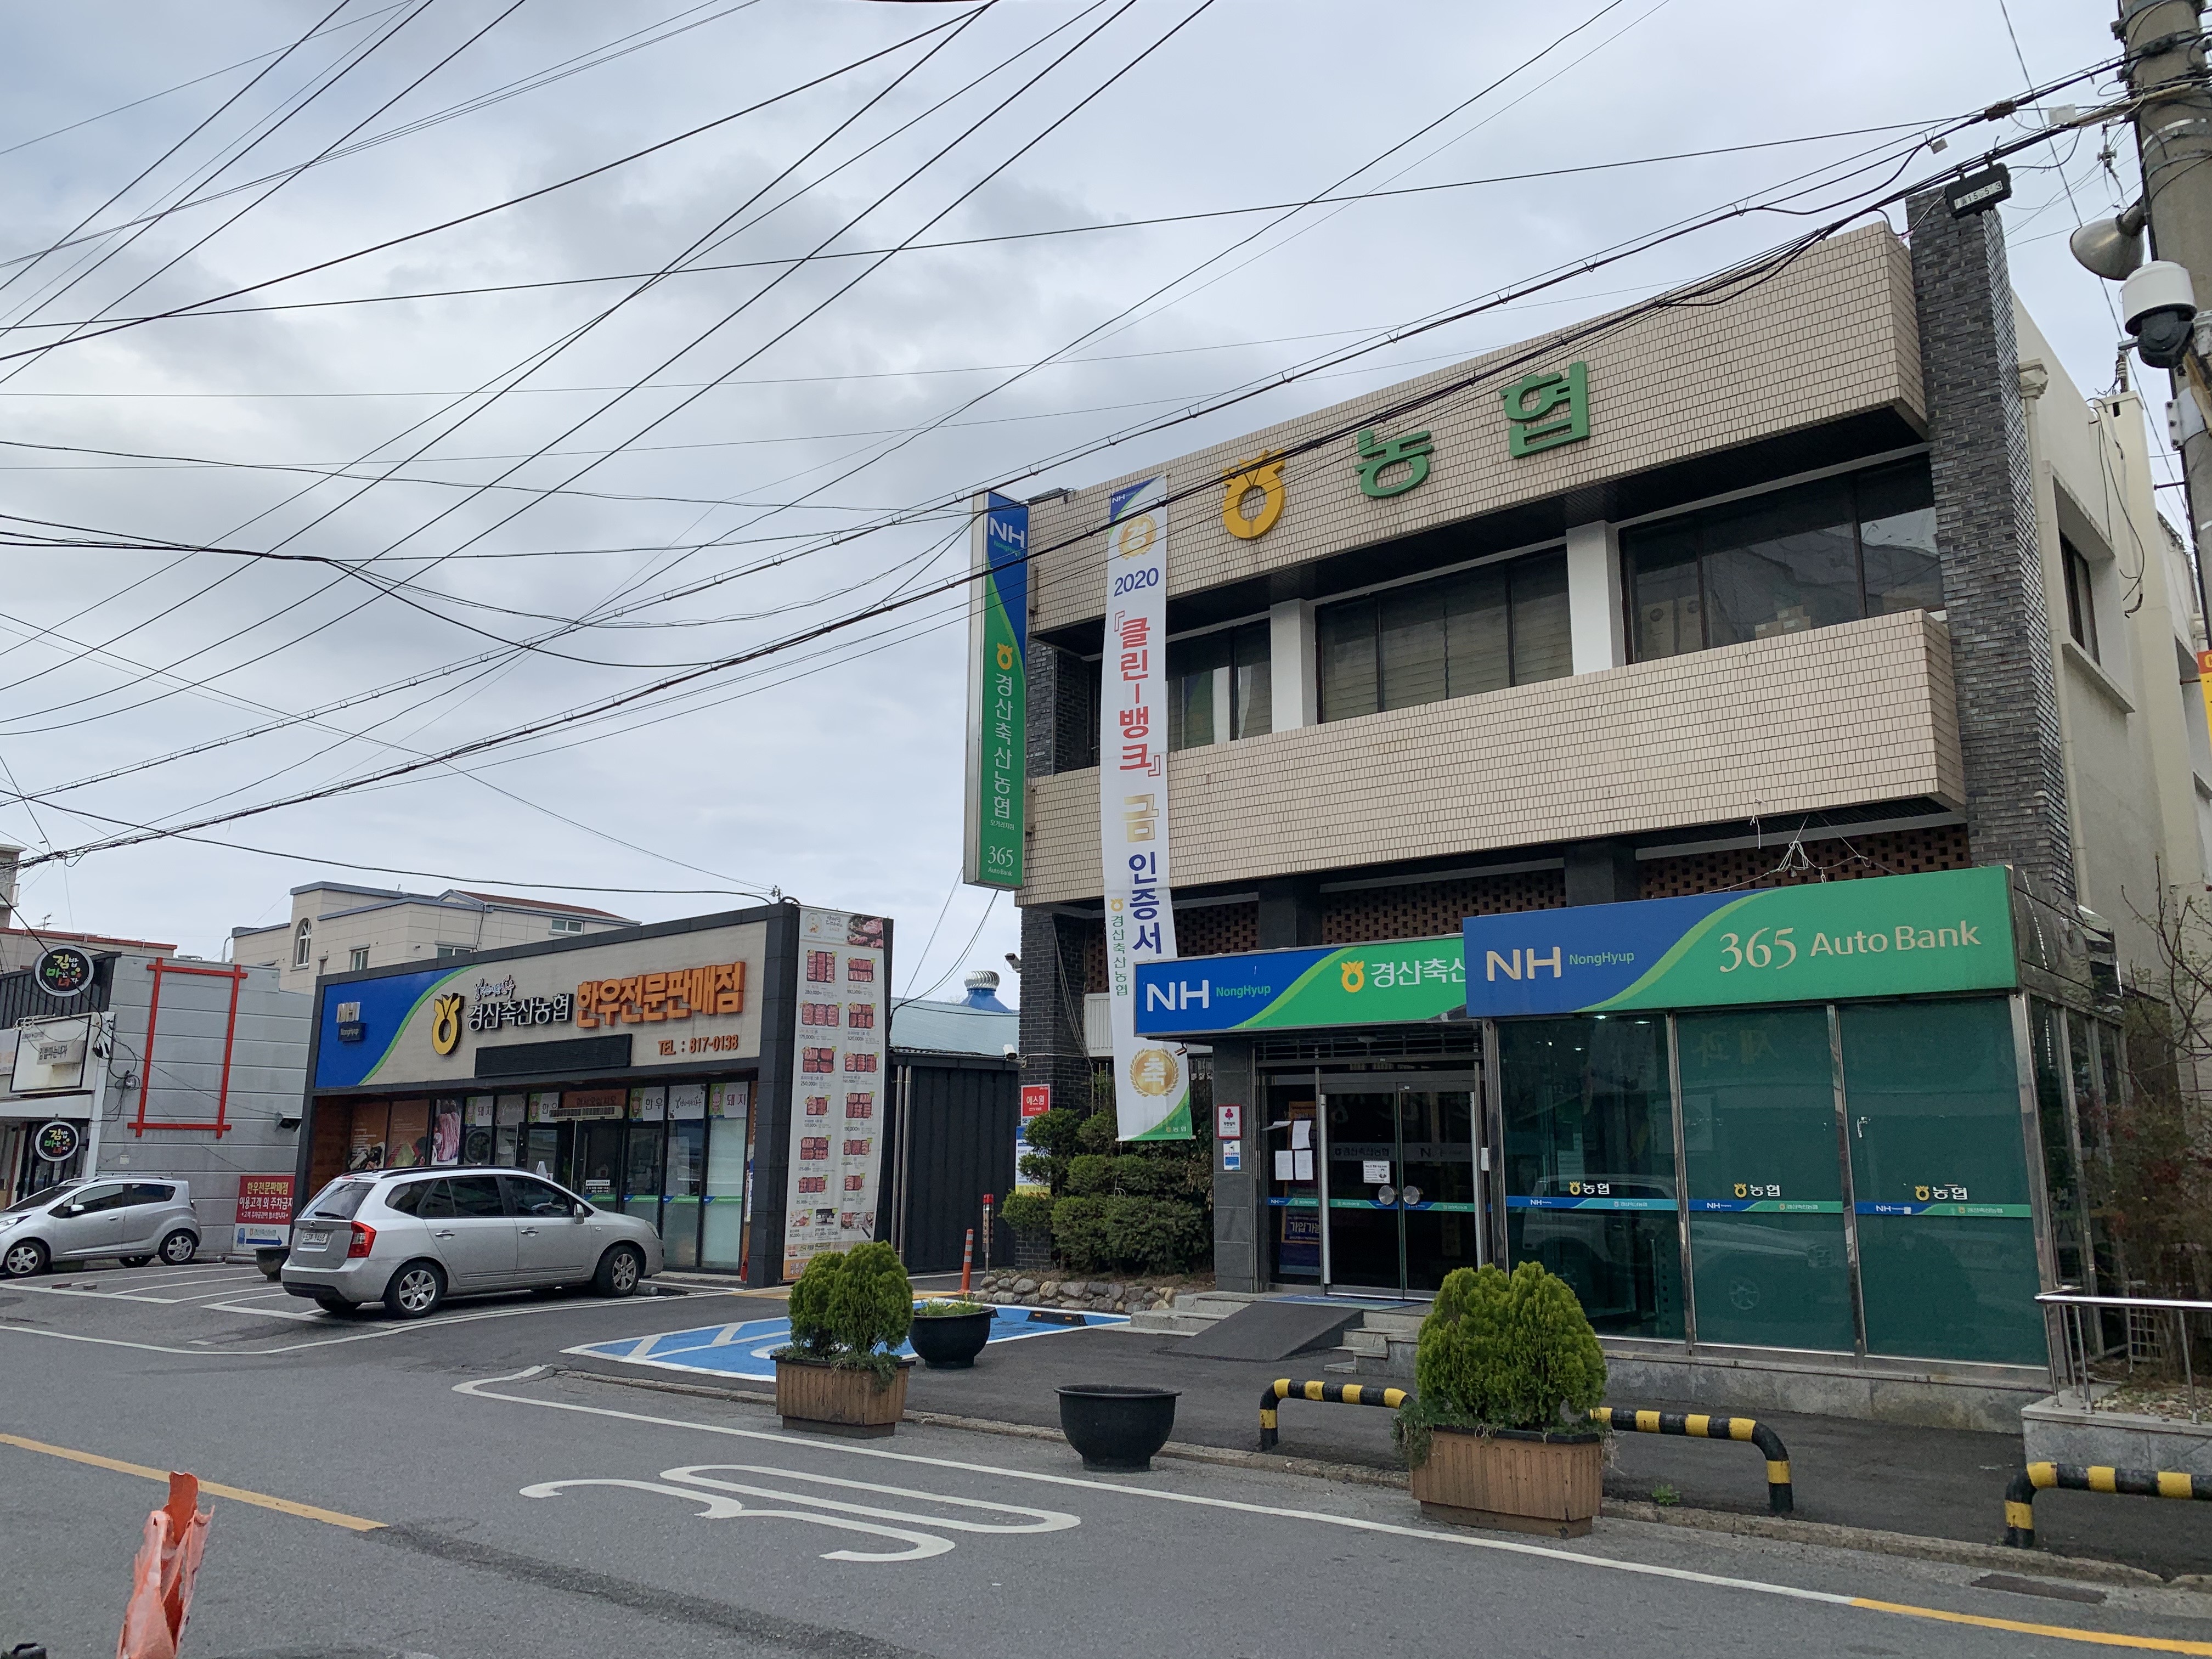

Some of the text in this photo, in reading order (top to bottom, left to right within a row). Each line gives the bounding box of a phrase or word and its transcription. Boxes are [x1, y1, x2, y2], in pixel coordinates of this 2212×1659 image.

[1355, 360, 1591, 499] 농협
[1112, 494, 1125, 504] NH
[990, 517, 1025, 548] NH
[1127, 522, 1148, 548] 경
[1114, 567, 1159, 597] 2020
[994, 673, 1013, 820] 경산축산농협
[990, 820, 1015, 831] 오거리지점
[1121, 793, 1159, 843] 금
[988, 845, 1014, 867] 365
[988, 866, 1000, 874] Auto
[1128, 851, 1163, 955] 인증서
[1110, 915, 1128, 997] 경산축산농협
[1719, 920, 1982, 973] 365 Auto Bank
[52, 954, 79, 969] 김밥
[1486, 946, 1635, 982] NH NongHyup
[468, 993, 573, 1032] 경산축산농협
[577, 961, 746, 1028] 한우전문판매점
[1146, 979, 1271, 1012] NH NongHyup
[336, 1001, 360, 1023] NH
[689, 1034, 738, 1054] 817-0138
[1141, 1057, 1167, 1086] 축
[477, 1104, 492, 1116] 돼지
[645, 1097, 663, 1110] 한우
[726, 1093, 746, 1106] 돼지
[1026, 1095, 1045, 1105] 에스원
[49, 1128, 69, 1140] 김밥
[247, 1182, 289, 1195] 한우전문판매점
[1583, 1183, 1610, 1195] 농협
[1750, 1184, 1781, 1197] 농협
[1933, 1186, 1968, 1200] 농협
[239, 1197, 262, 1210] 이용고객
[263, 1197, 269, 1210] 외
